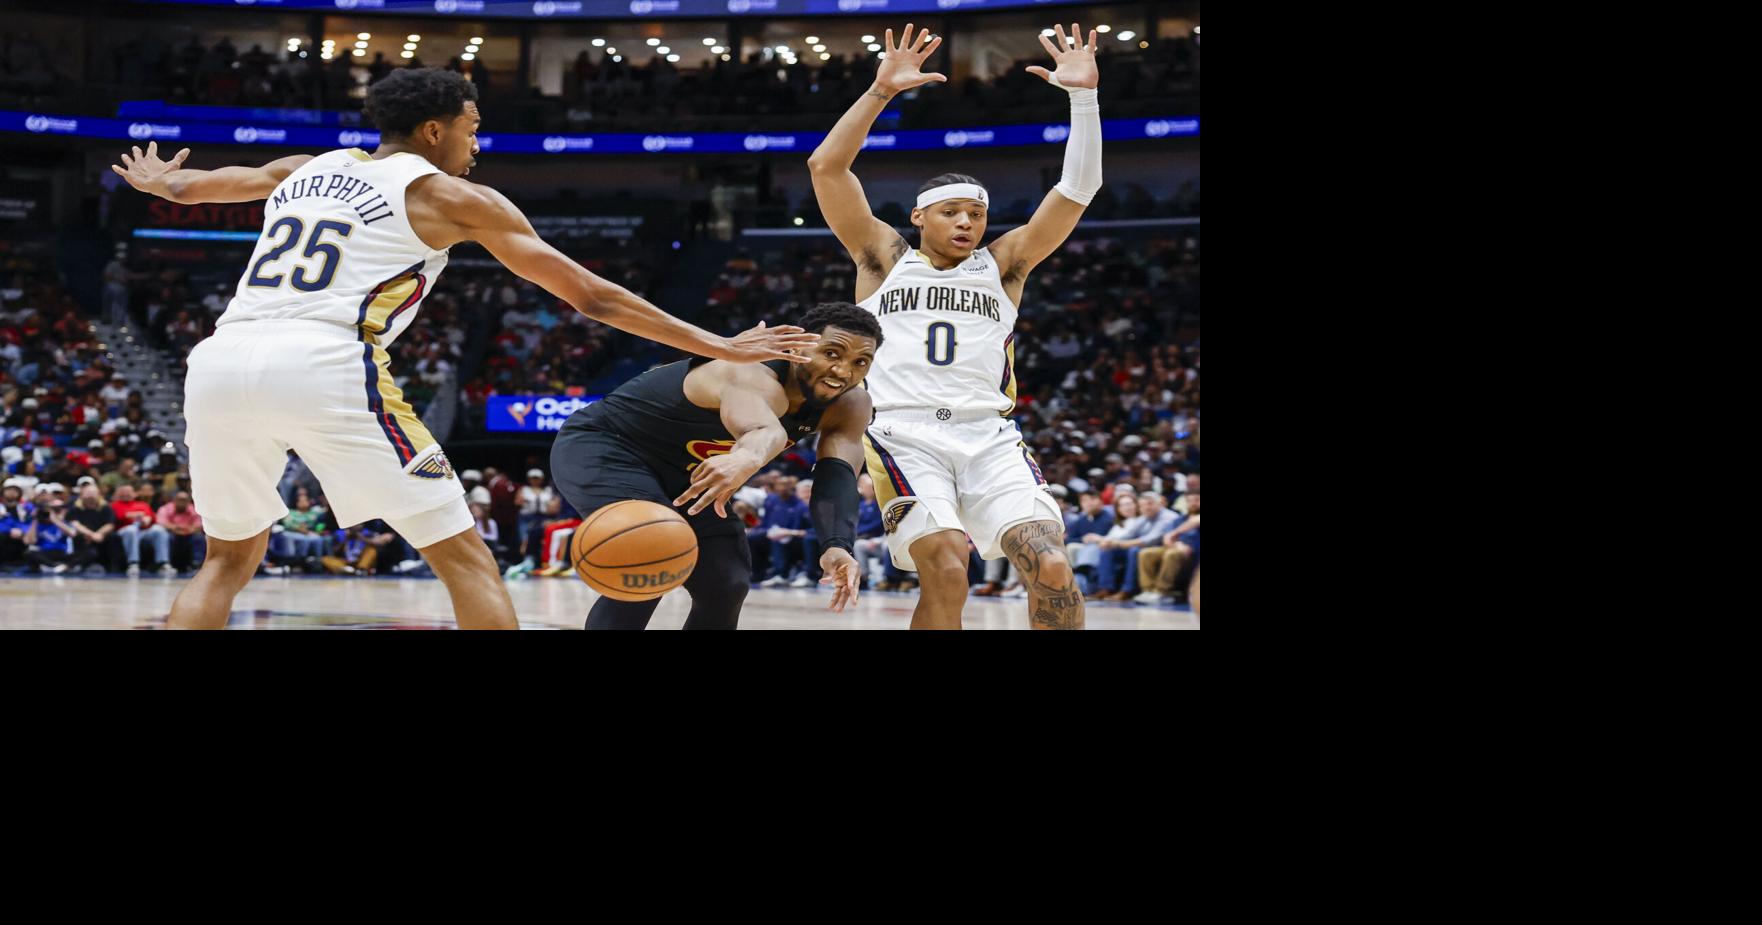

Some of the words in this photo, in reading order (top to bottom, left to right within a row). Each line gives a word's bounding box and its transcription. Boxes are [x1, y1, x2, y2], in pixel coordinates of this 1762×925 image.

[272, 174, 374, 210] MURPHY
[354, 193, 394, 226] III
[246, 214, 356, 293] 25
[878, 286, 921, 317] NEW
[926, 285, 1001, 322] ORLEANS
[925, 320, 958, 367] 0
